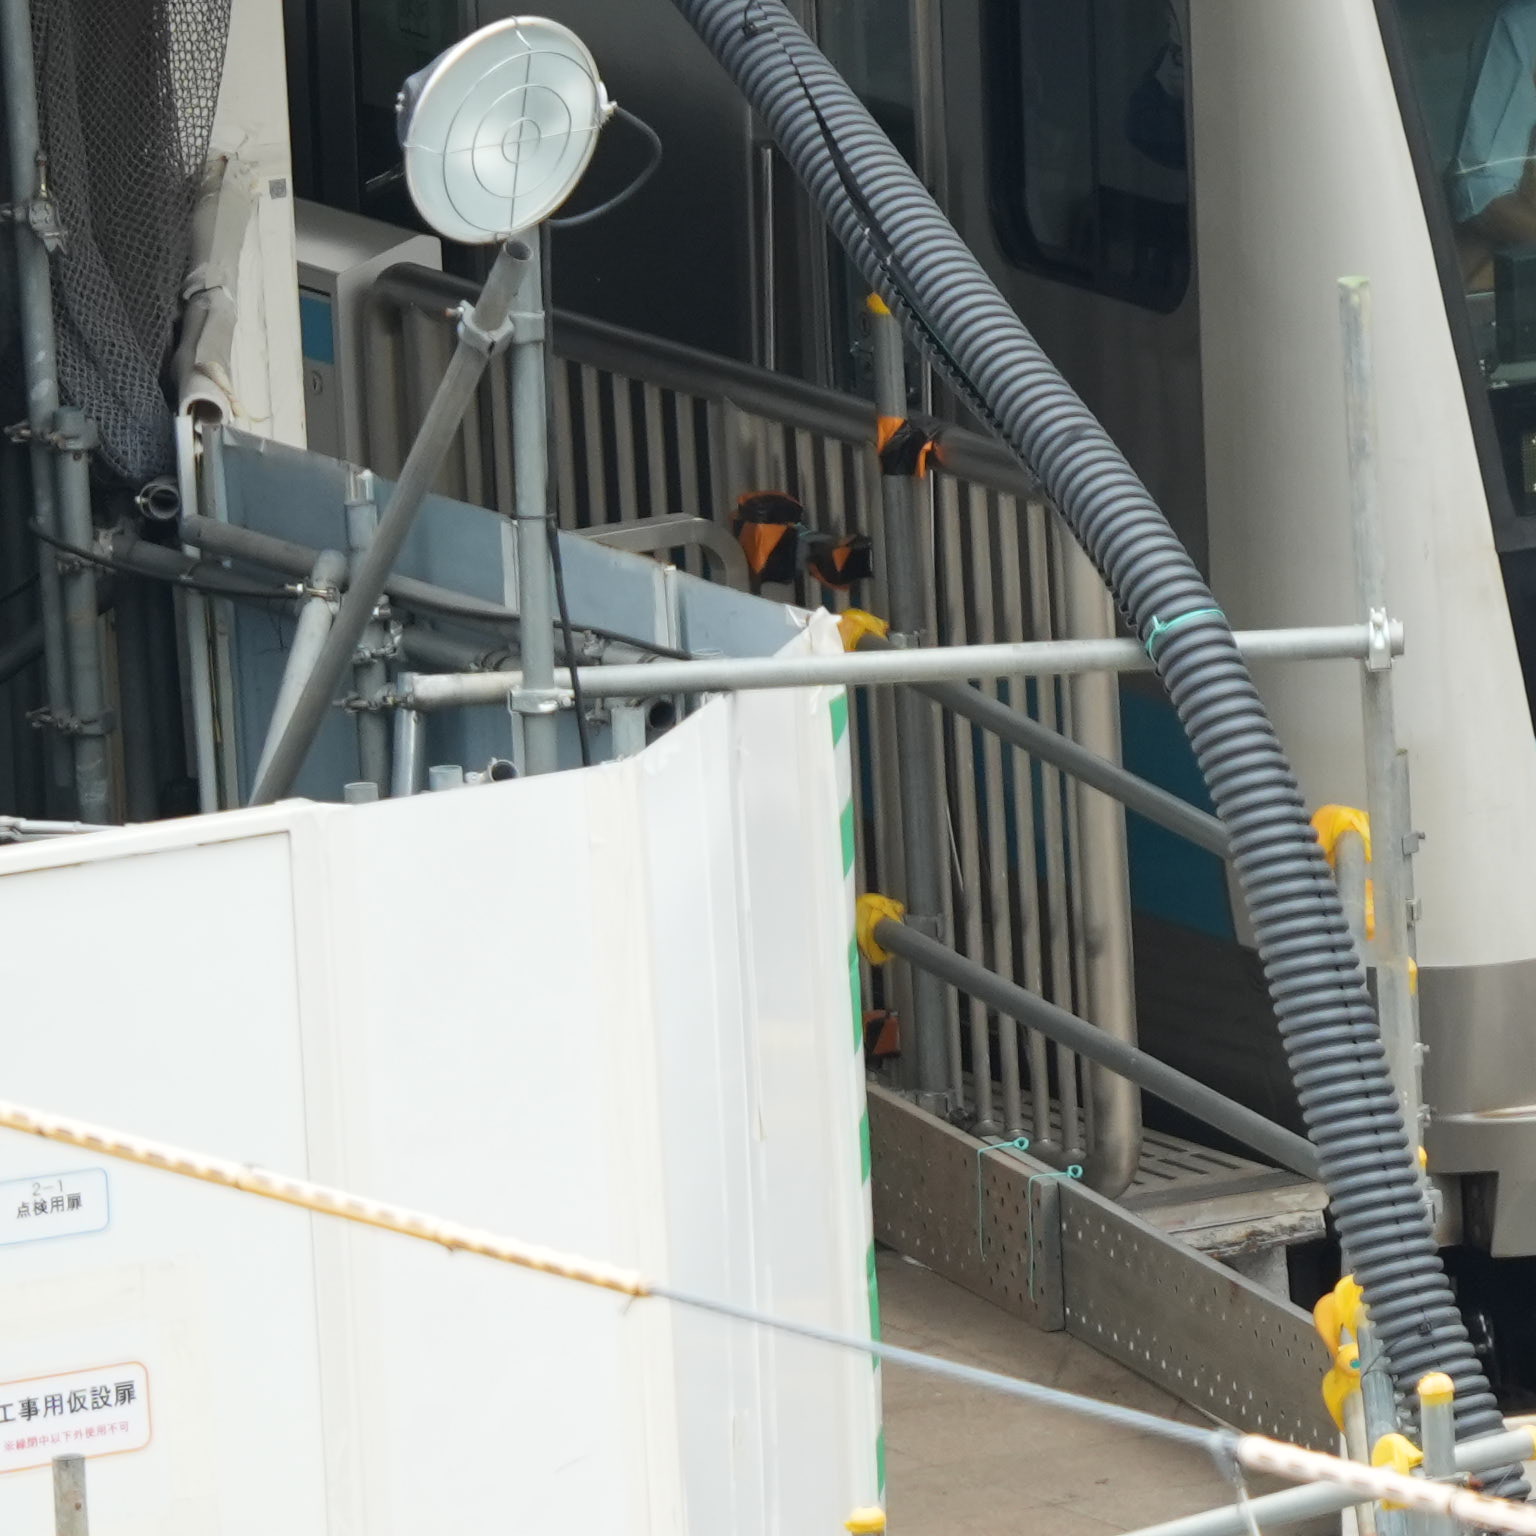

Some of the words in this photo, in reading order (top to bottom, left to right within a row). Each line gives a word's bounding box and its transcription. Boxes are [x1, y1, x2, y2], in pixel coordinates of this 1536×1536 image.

[17, 1192, 82, 1219] 点検用扉
[0, 1380, 136, 1423] 工事用仮設扉
